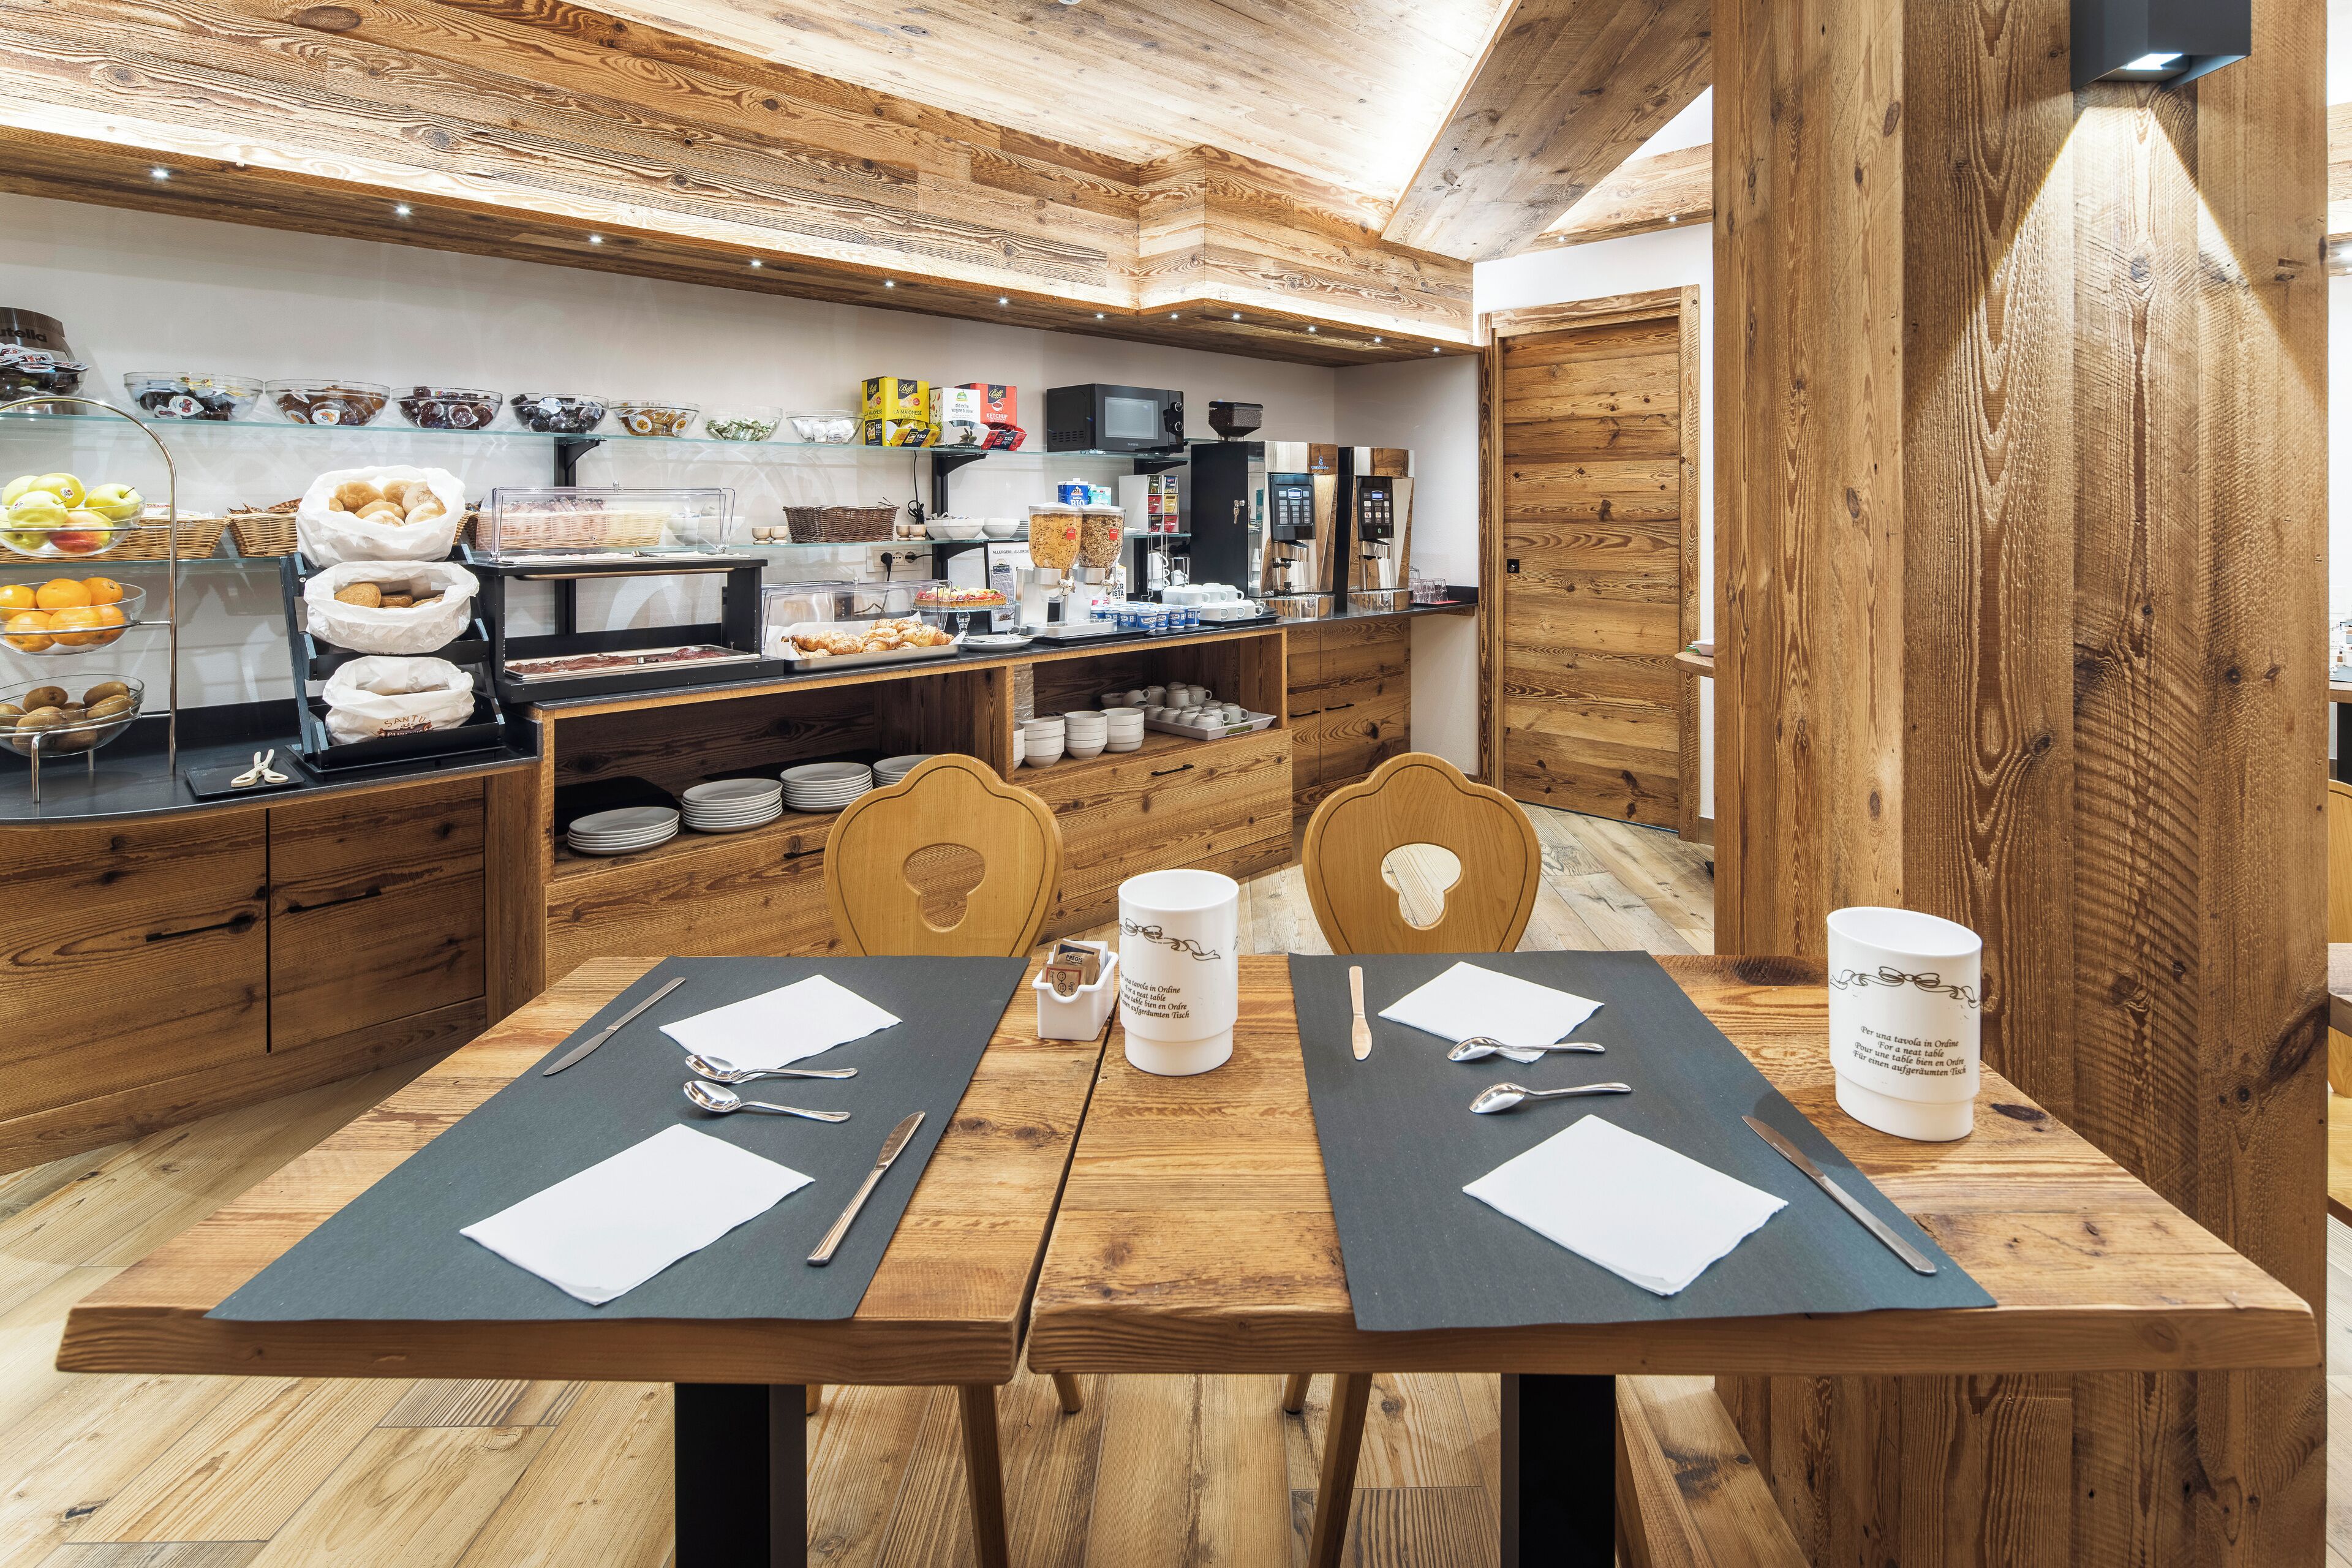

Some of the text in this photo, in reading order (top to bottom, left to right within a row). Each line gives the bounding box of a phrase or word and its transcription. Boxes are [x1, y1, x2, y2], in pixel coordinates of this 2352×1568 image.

[899, 383, 914, 394] Biffi
[989, 389, 1004, 399] Biffi
[1066, 954, 1083, 963] PREGIS
[1132, 980, 1148, 990] tavola
[1131, 997, 1143, 1005] table
[1144, 1000, 1156, 1008] bien
[1131, 1005, 1170, 1018] aufgeräumten
[1171, 1010, 1189, 1019] Tisch
[1861, 1026, 1959, 1048] Per una tavola in Ordine
[1855, 1042, 1873, 1054] Pour
[1892, 1054, 1913, 1064] table
[1916, 1057, 1933, 1066] bien
[1946, 1057, 1964, 1066] Ordre
[1877, 1041, 1893, 1050] For
[1903, 1048, 1921, 1057] neat
[1924, 1049, 1944, 1058] table
[1853, 1050, 1966, 1076] Für einen aufgeräumten Tisch
